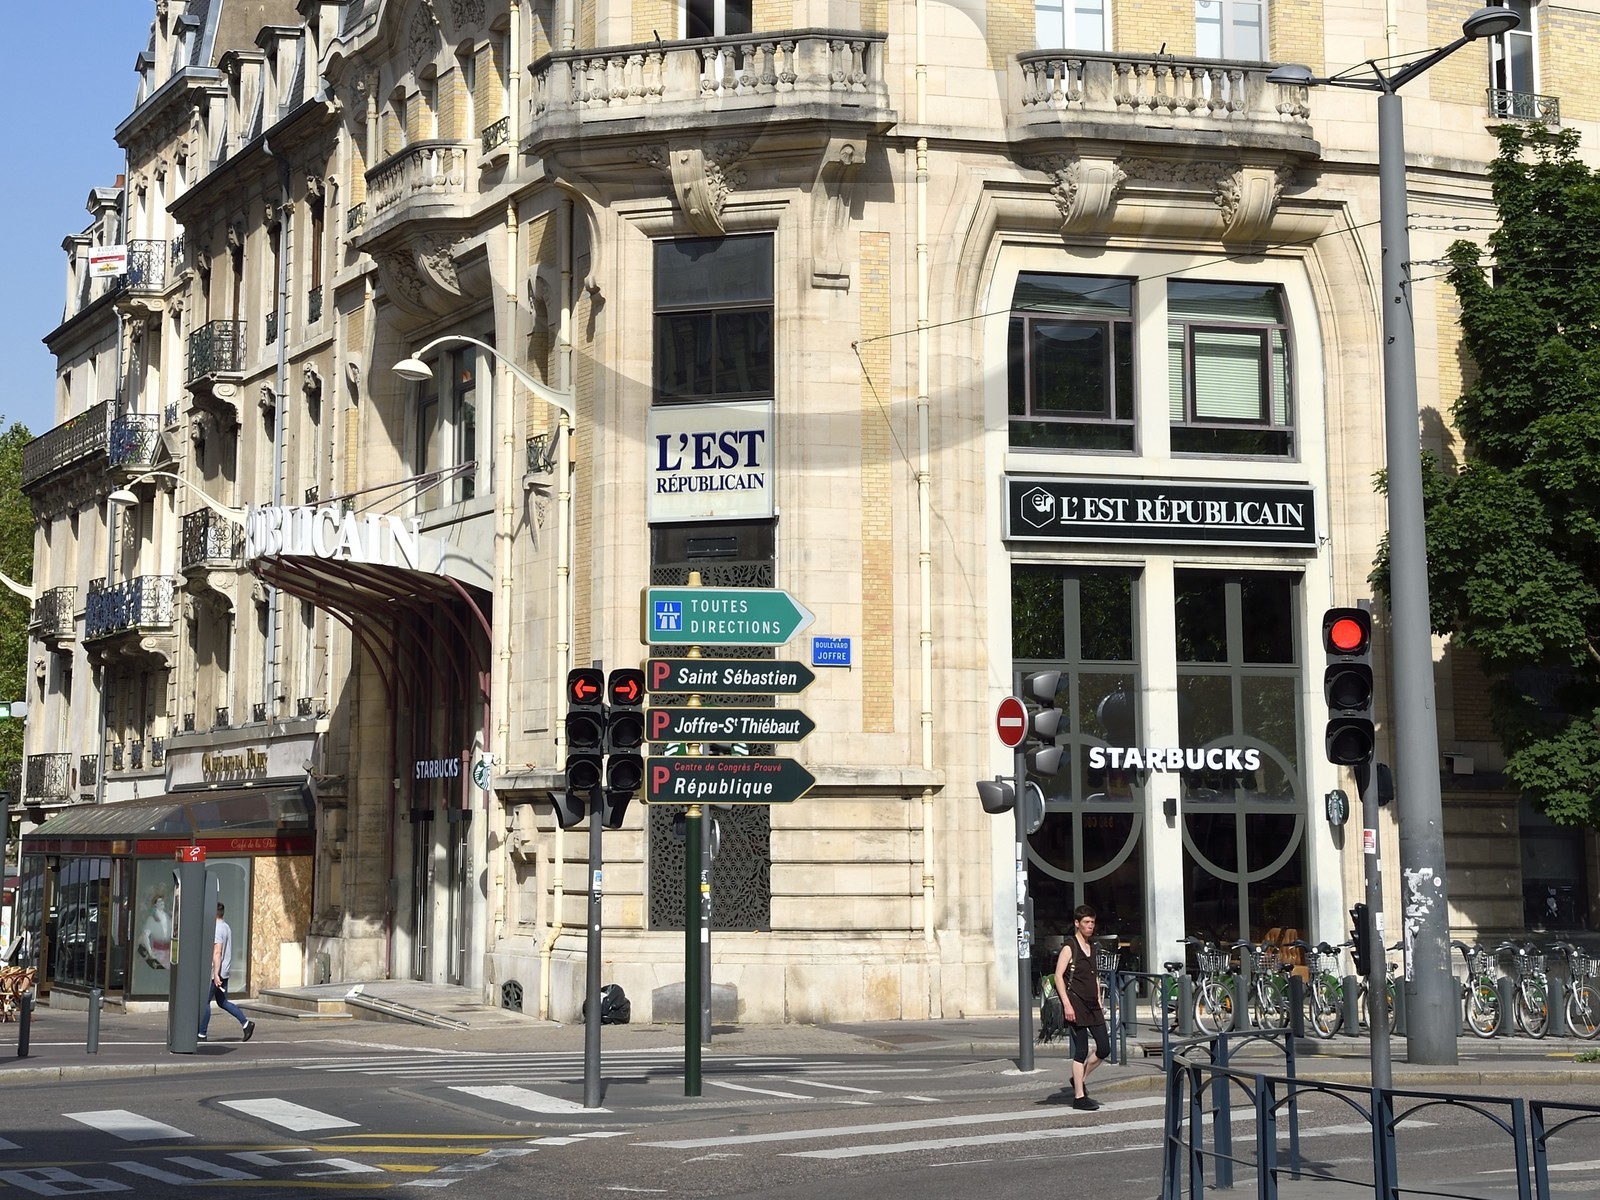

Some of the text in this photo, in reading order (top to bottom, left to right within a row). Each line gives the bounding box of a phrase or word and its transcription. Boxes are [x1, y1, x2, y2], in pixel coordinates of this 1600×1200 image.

[655, 430, 765, 471] L'EST
[656, 473, 765, 493] RÉPUBLICAIN
[1060, 495, 1130, 521] L'EST
[1136, 494, 1305, 526] RÉPUBLICAIN
[690, 599, 748, 613] TOUTES
[690, 620, 781, 634] DIRECTIONS
[815, 641, 849, 649] BOULEVARD
[817, 651, 847, 660] JOFFRE
[677, 667, 718, 685] Saint
[722, 668, 797, 686] Sébastien
[741, 717, 800, 734] Thiébaut
[674, 762, 782, 774] Centre de Congrès Prouvé
[1089, 746, 1261, 771] STARBUCKS
[415, 757, 459, 780] STARBUCKS
[674, 777, 773, 799] République
[0, 1148, 386, 1197] BUS
